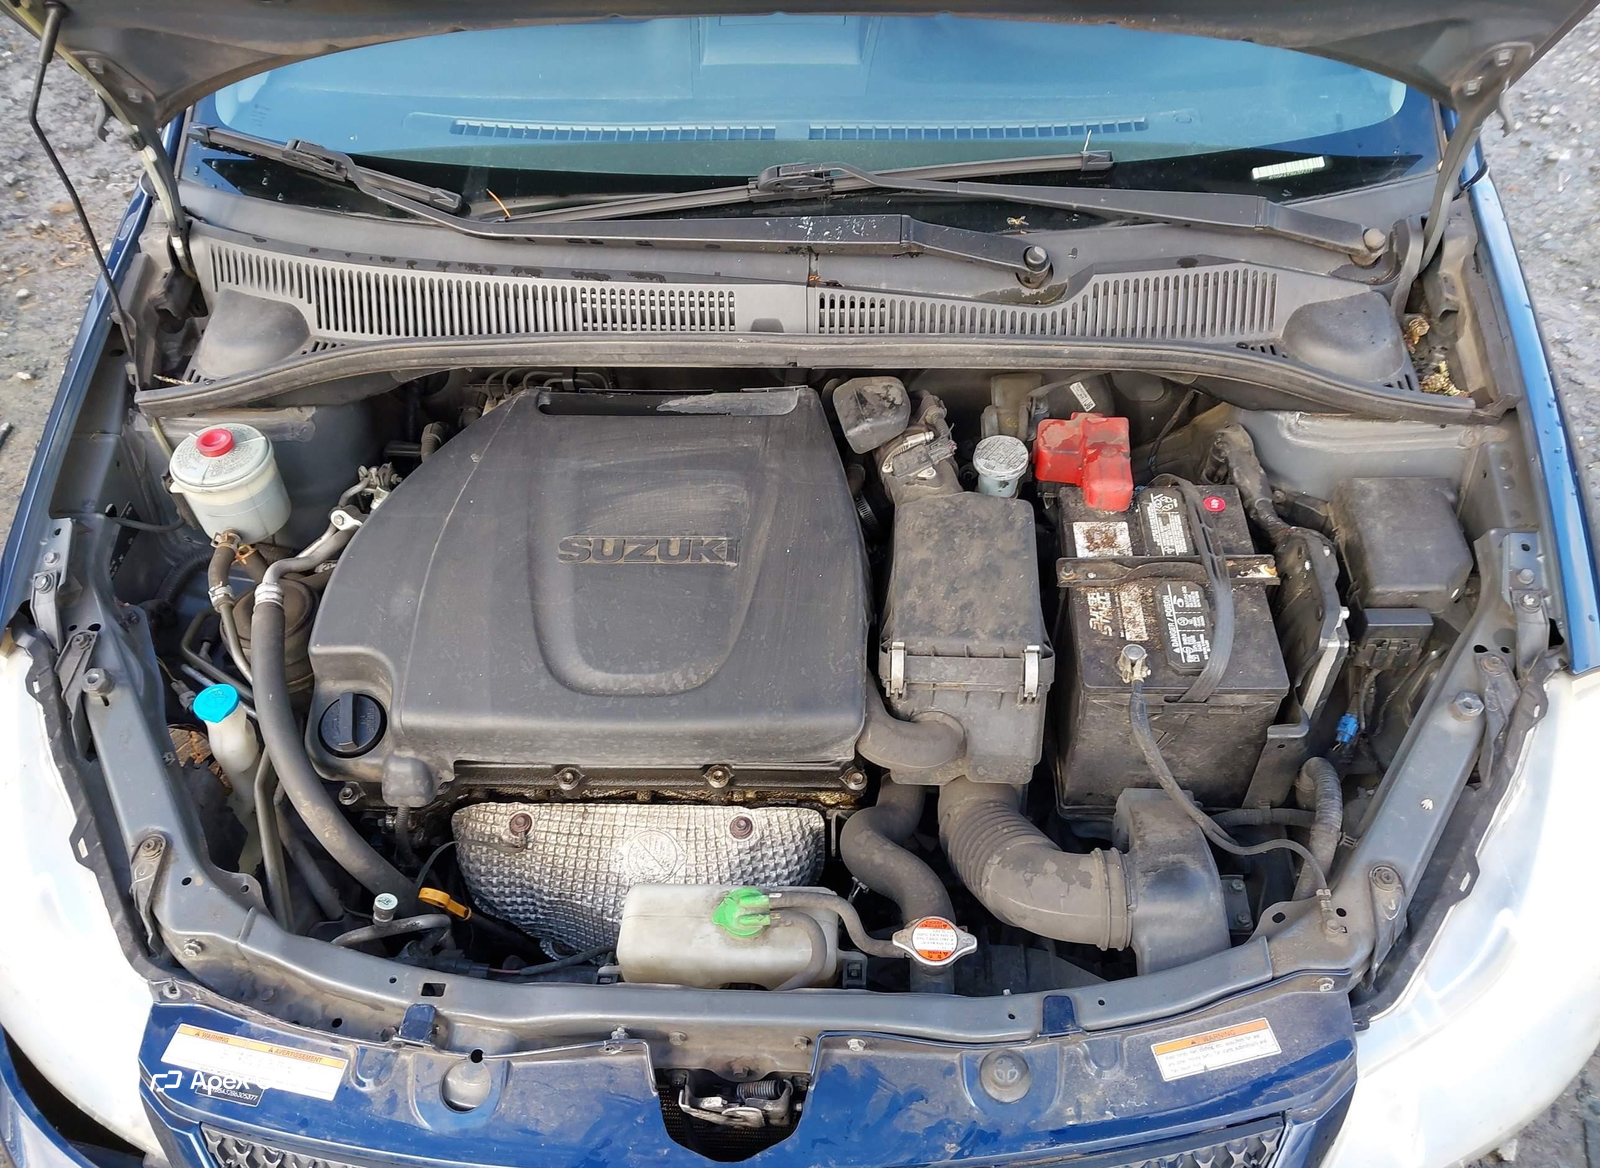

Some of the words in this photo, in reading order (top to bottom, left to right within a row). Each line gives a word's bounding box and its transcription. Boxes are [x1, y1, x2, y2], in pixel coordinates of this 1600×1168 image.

[558, 536, 740, 565] SUZUKI
[1162, 595, 1173, 617] POISON
[1168, 622, 1180, 648] DANGER
[202, 1031, 230, 1043] WARNING
[1203, 1029, 1236, 1042] WARNING
[275, 1048, 323, 1063] AVERTISSEMENT
